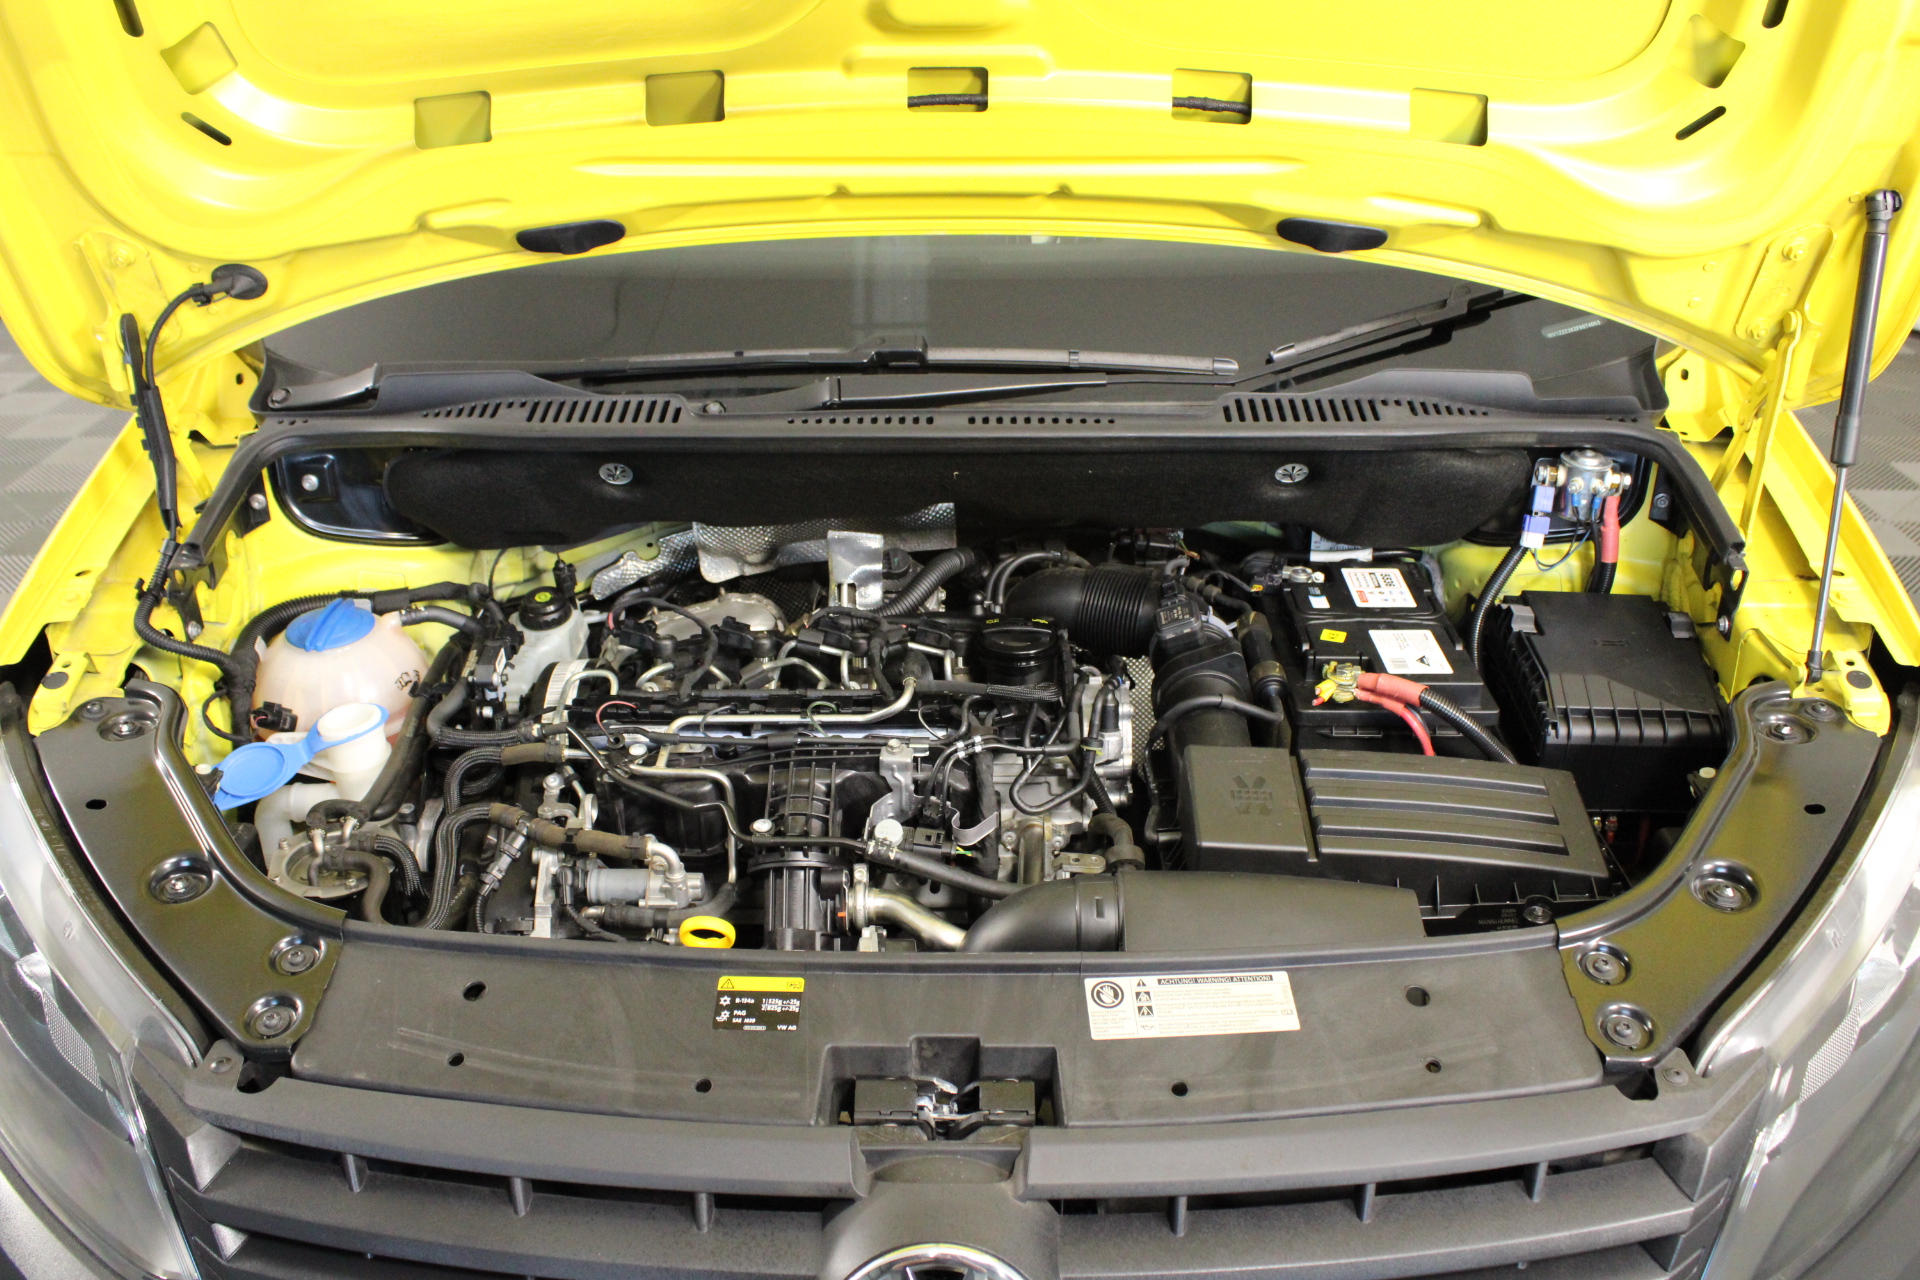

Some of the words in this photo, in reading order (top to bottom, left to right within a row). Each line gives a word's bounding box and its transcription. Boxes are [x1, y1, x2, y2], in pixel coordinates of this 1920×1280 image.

[1160, 977, 1196, 985] ACHTUNG!
[1196, 976, 1231, 984] WARNING!
[1232, 975, 1271, 983] ATTENTION!
